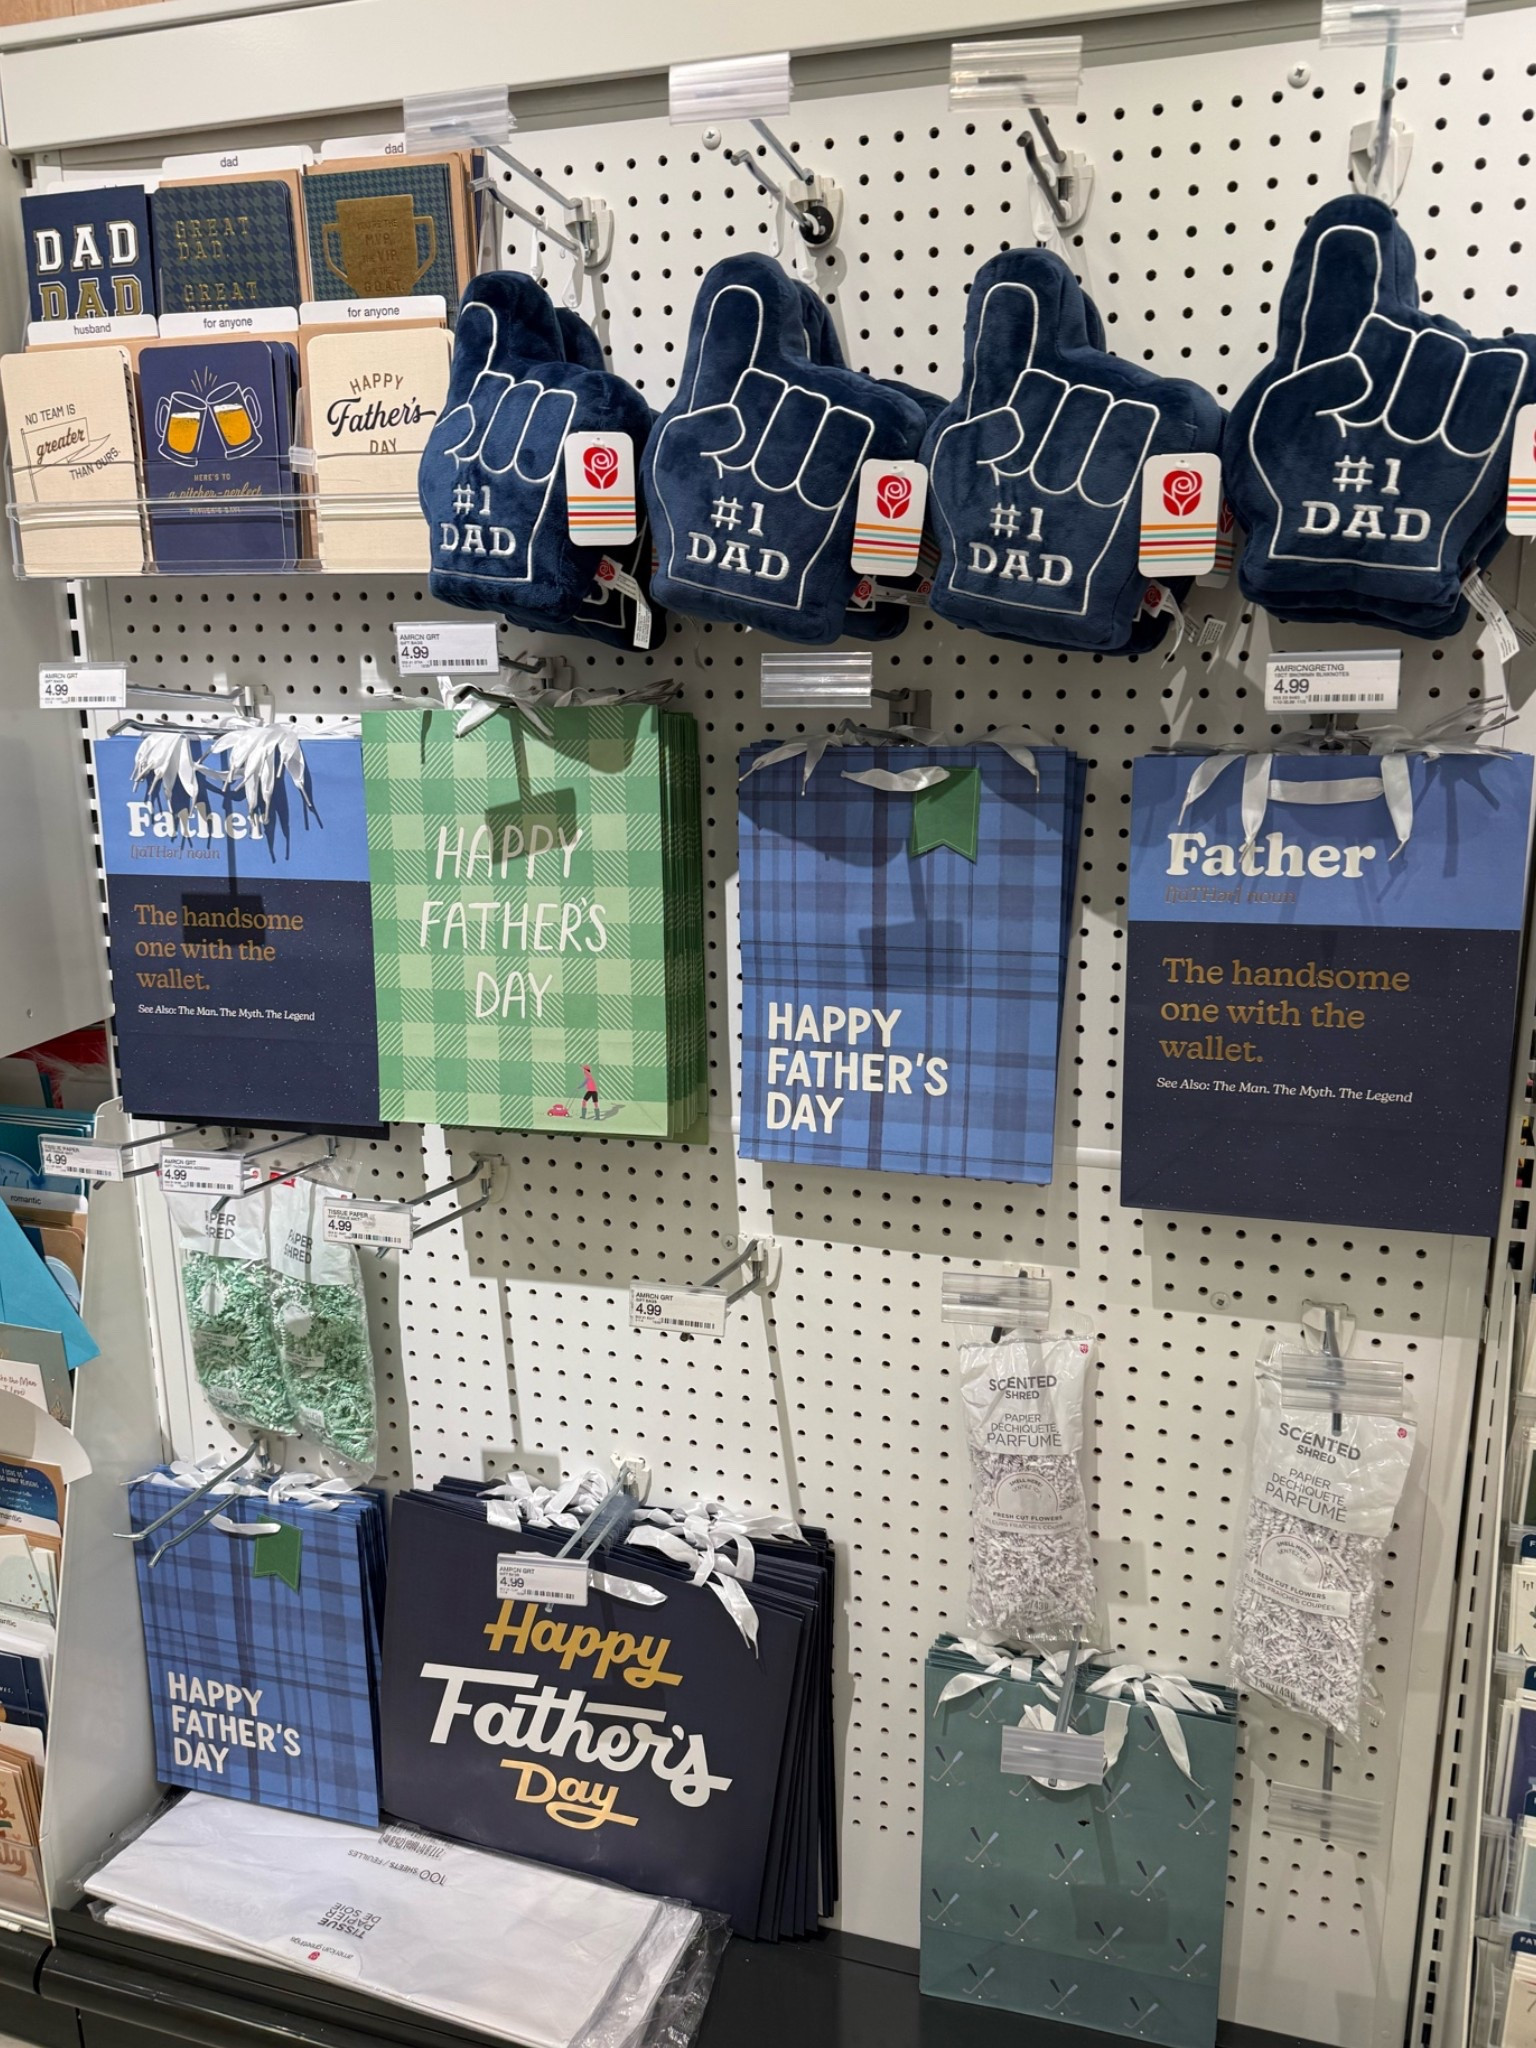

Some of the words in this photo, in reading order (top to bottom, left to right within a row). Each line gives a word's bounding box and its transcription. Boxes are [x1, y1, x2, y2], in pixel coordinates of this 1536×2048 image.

[384, 143, 404, 154] dad
[220, 156, 238, 167] dad
[175, 216, 248, 239] GREAT
[33, 220, 139, 275] DAD
[39, 274, 143, 321] DAD
[183, 281, 257, 302] GREAT
[348, 307, 362, 318] for
[364, 306, 400, 318] anyone
[74, 324, 112, 335] husband
[204, 318, 216, 328] for
[219, 318, 252, 329] anyone
[350, 372, 404, 395] HAPPY
[25, 413, 38, 426] NO
[40, 406, 64, 422] TEAM
[66, 404, 76, 415] IS
[327, 396, 437, 438] Father's
[36, 427, 86, 464] greater
[370, 438, 397, 454] DAY
[69, 464, 94, 480] THAN
[1332, 454, 1402, 495] #1
[453, 483, 491, 516] #1
[710, 496, 765, 537] #1
[989, 502, 1044, 542] #1
[1298, 501, 1431, 542] DAD
[440, 523, 517, 557] DAD
[686, 531, 790, 581] DAD
[967, 542, 1073, 587] DAD
[402, 646, 429, 659] 4.99
[45, 684, 68, 696] 4.99
[1274, 678, 1310, 694] 4.99
[126, 801, 266, 839] Father
[186, 848, 220, 860] noun
[435, 824, 583, 880] HAPPY
[1166, 832, 1376, 878] Father
[1246, 891, 1297, 904] noun
[134, 904, 178, 926] The
[182, 906, 304, 931] handsome
[420, 897, 608, 952] FATHER'S
[135, 941, 176, 958] one
[180, 938, 233, 960] with
[238, 940, 276, 961] the
[136, 968, 210, 990] wallet.
[1162, 957, 1224, 985] The
[1232, 959, 1411, 992] handsome
[476, 971, 553, 1019] DAY
[138, 1004, 154, 1014] See
[155, 1005, 176, 1014] Also:
[178, 1006, 195, 1015] The
[196, 1007, 218, 1016] Man.
[220, 1008, 236, 1017] The
[238, 1008, 264, 1020] Myth.
[266, 1010, 282, 1020] The
[284, 1010, 315, 1022] Legend
[1160, 1001, 1220, 1024] one
[1226, 1000, 1302, 1026] with
[1310, 1002, 1366, 1030] the
[768, 1002, 902, 1047] HAPPY
[1159, 1034, 1264, 1063] wallet.
[768, 1047, 948, 1096] FATHER'S
[1156, 1077, 1179, 1090] See
[1180, 1078, 1211, 1091] Also:
[1213, 1080, 1236, 1092] The
[1238, 1082, 1270, 1094] Man.
[1273, 1084, 1296, 1096] The
[1299, 1085, 1336, 1100] Myth.
[1338, 1088, 1364, 1100] The
[1366, 1089, 1413, 1104] Legend
[766, 1091, 844, 1134] DAY
[46, 1153, 68, 1165] 4.99
[164, 1168, 188, 1180] 4.99
[10, 1194, 42, 1205] romantic
[328, 1208, 348, 1216] TISSUE
[328, 1219, 352, 1232] 4.99
[636, 1292, 659, 1300] AMRCN
[636, 1303, 662, 1316] 4.99
[989, 1375, 1058, 1391] SCENTED
[1005, 1390, 1040, 1400] SHRED
[1004, 1413, 1041, 1422] PAPIER
[1278, 1422, 1361, 1460] SCENTED
[1296, 1444, 1337, 1464] SHRED
[1289, 1468, 1332, 1490] PAPIER
[500, 1577, 524, 1588] 4.99
[1254, 1568, 1274, 1582] FRESH
[1275, 1580, 1289, 1589] CUT
[1290, 1586, 1326, 1600] FLOWERS
[483, 1598, 684, 1689] Happy
[168, 1671, 263, 1717] HAPPY
[171, 1704, 302, 1757] FATHER'S
[420, 1662, 733, 1808] Father's
[174, 1736, 230, 1774] DAY
[500, 1758, 640, 1830] Day
[348, 1850, 384, 1866] FEUILLES
[389, 1861, 418, 1875] SHEETS
[420, 1869, 448, 1886] 100
[326, 1908, 375, 1931] PAPIER
[334, 1902, 362, 1916] SOIE
[365, 1912, 382, 1924] DE
[318, 1918, 366, 1940] TISSUE
[290, 1936, 322, 1950] greetings
[322, 1946, 354, 1960] american
